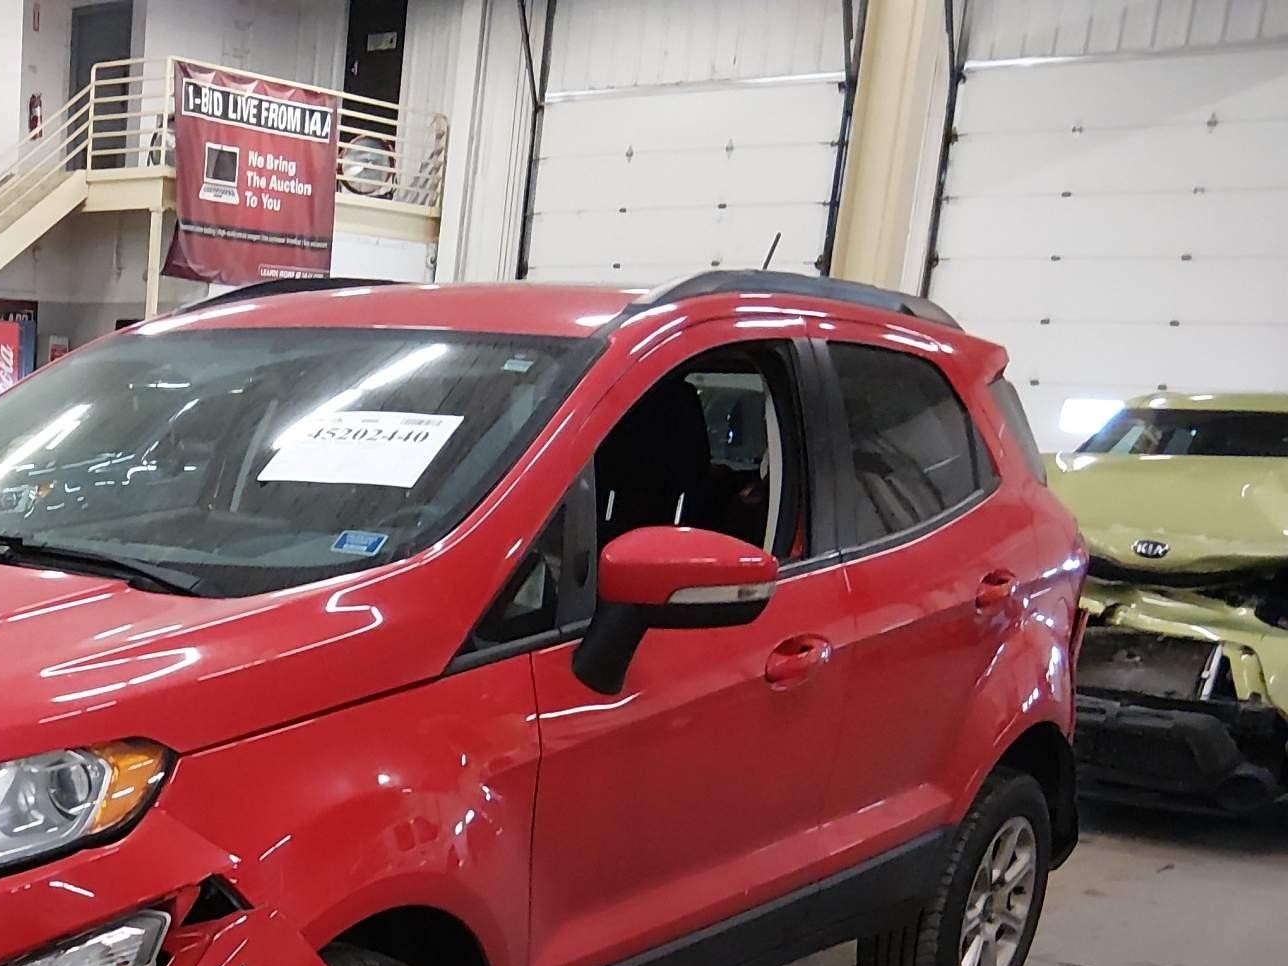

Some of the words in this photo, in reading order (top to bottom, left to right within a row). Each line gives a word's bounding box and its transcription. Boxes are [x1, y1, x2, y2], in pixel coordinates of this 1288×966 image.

[228, 92, 258, 124] LIVE
[260, 101, 301, 134] FROM
[266, 153, 297, 177] Bring
[246, 170, 267, 189] The
[268, 174, 312, 197] Auction
[244, 190, 258, 208] To
[261, 192, 281, 212] You
[1136, 542, 1163, 556] KIA
